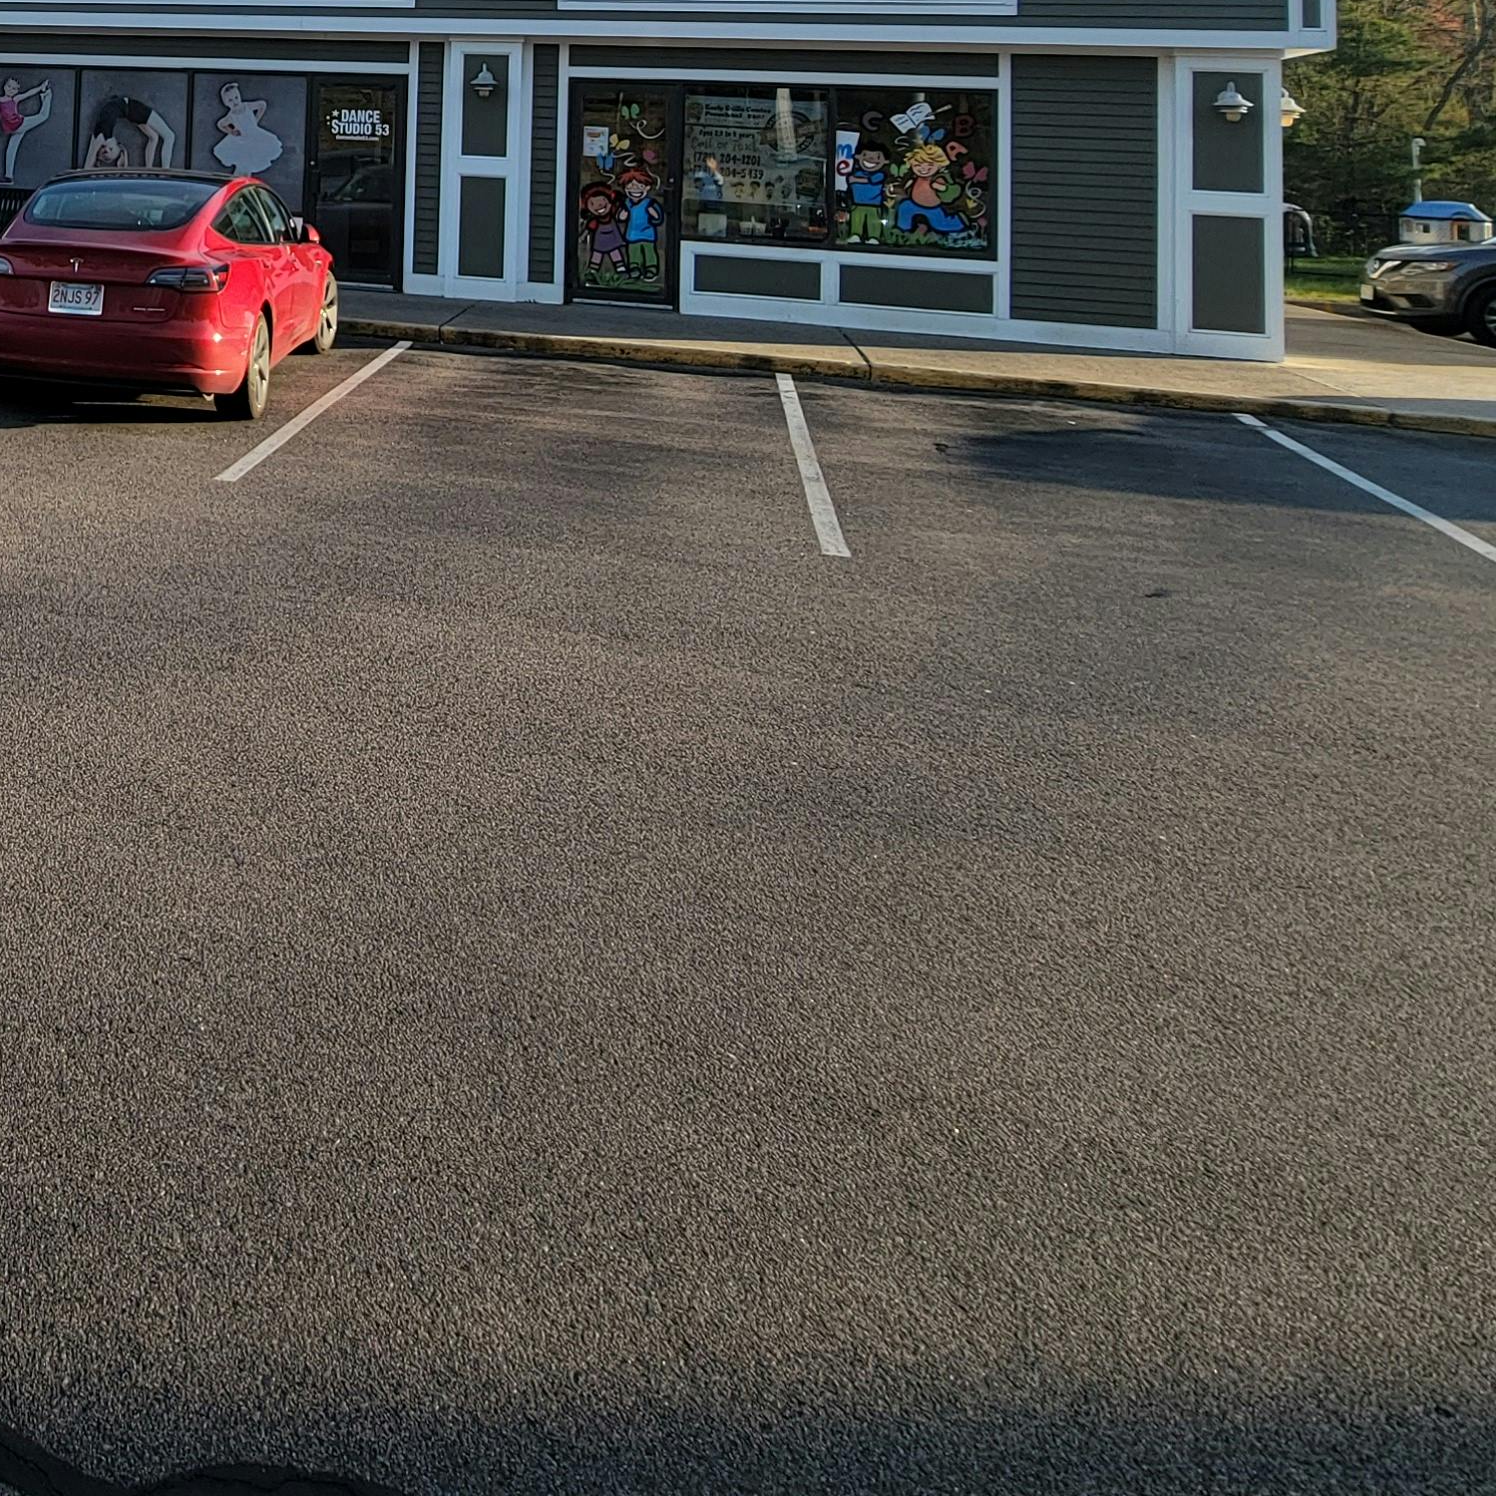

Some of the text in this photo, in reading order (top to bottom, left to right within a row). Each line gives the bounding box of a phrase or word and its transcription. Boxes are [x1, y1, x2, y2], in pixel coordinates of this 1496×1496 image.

[341, 109, 381, 123] DANCE
[331, 119, 390, 136] STUDIO 53
[52, 288, 100, 306] 2NJS 97
